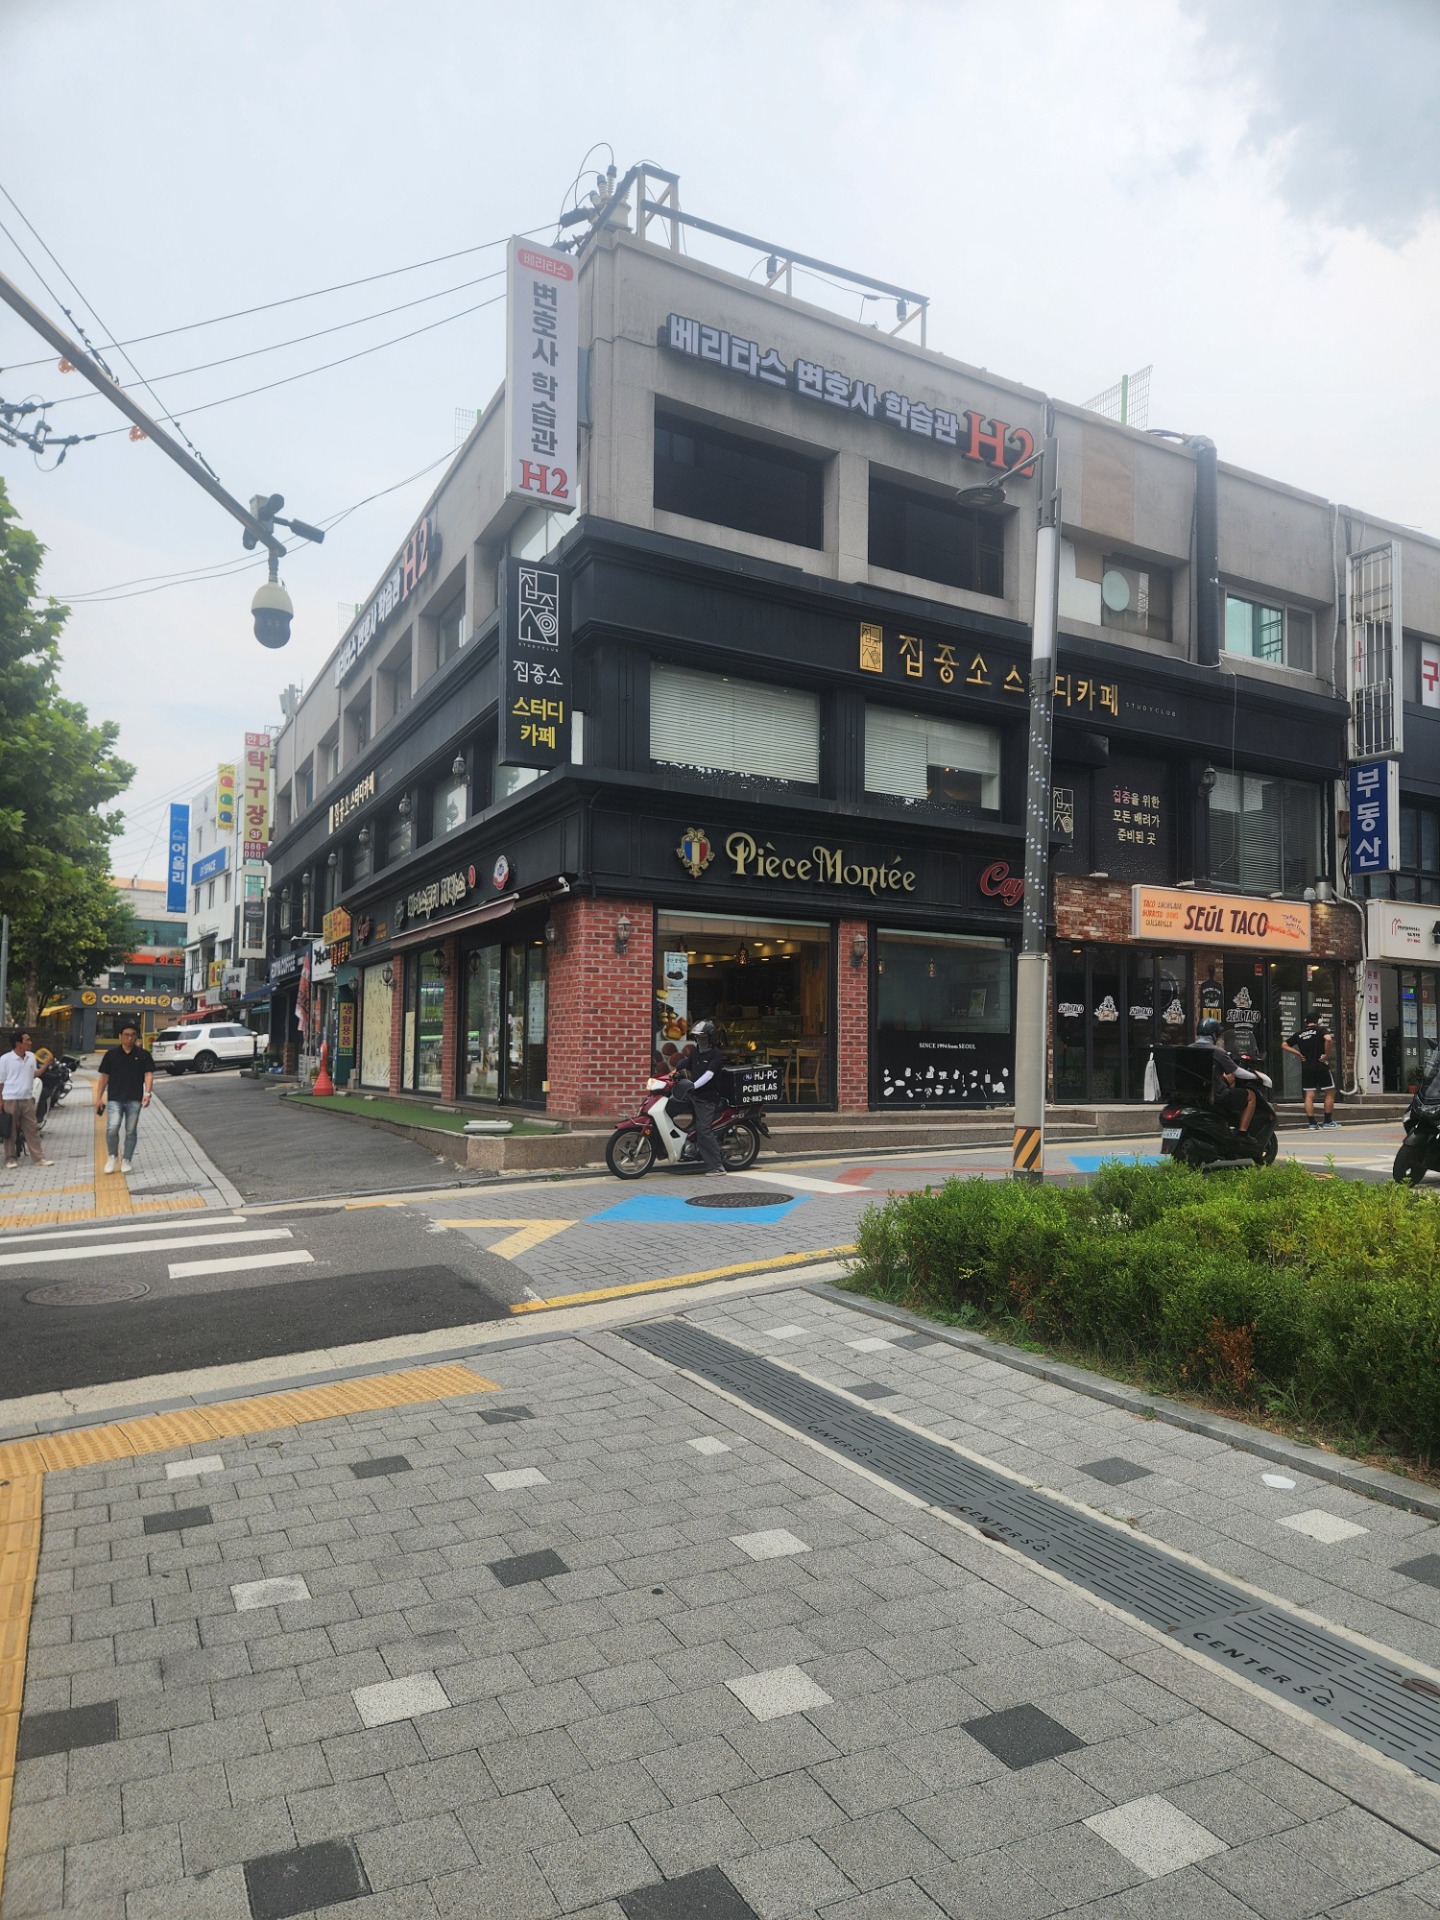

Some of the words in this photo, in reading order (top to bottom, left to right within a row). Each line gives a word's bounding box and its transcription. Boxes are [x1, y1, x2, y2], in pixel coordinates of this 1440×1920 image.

[523, 252, 568, 278] 베리타스
[531, 281, 559, 367] 변호사
[531, 371, 559, 457] 학습관
[669, 313, 787, 386] 베리타스
[796, 358, 877, 418] 변호사
[884, 391, 959, 445] 학습관
[961, 410, 1035, 479] H2
[519, 459, 569, 499] H2
[402, 517, 432, 602] H2
[512, 660, 564, 686] 집중소
[899, 634, 1118, 716] 집중소스디카페
[512, 696, 564, 724] 스터디
[520, 723, 556, 750] 카페
[246, 750, 267, 826] 탁구장
[1112, 789, 1140, 806] 집중을
[1142, 794, 1160, 809] 위한
[250, 831, 261, 840] 3F
[1113, 809, 1131, 824] 모든
[1133, 811, 1160, 828] 배려가
[1354, 768, 1382, 869] 부동산
[1117, 828, 1144, 844] 준비된
[1146, 832, 1157, 846] 곳
[725, 831, 812, 881] Pièce
[812, 845, 916, 896] Montée
[1230, 909, 1269, 937] TACO
[101, 994, 157, 1005] COMPOSE
[342, 1005, 353, 1046] 생활용품
[1368, 1011, 1380, 1085] 부동산
[754, 1070, 778, 1080] HJ-PC
[960, 1506, 1022, 1538] CENTER
[1193, 1632, 1291, 1684] CENTER
